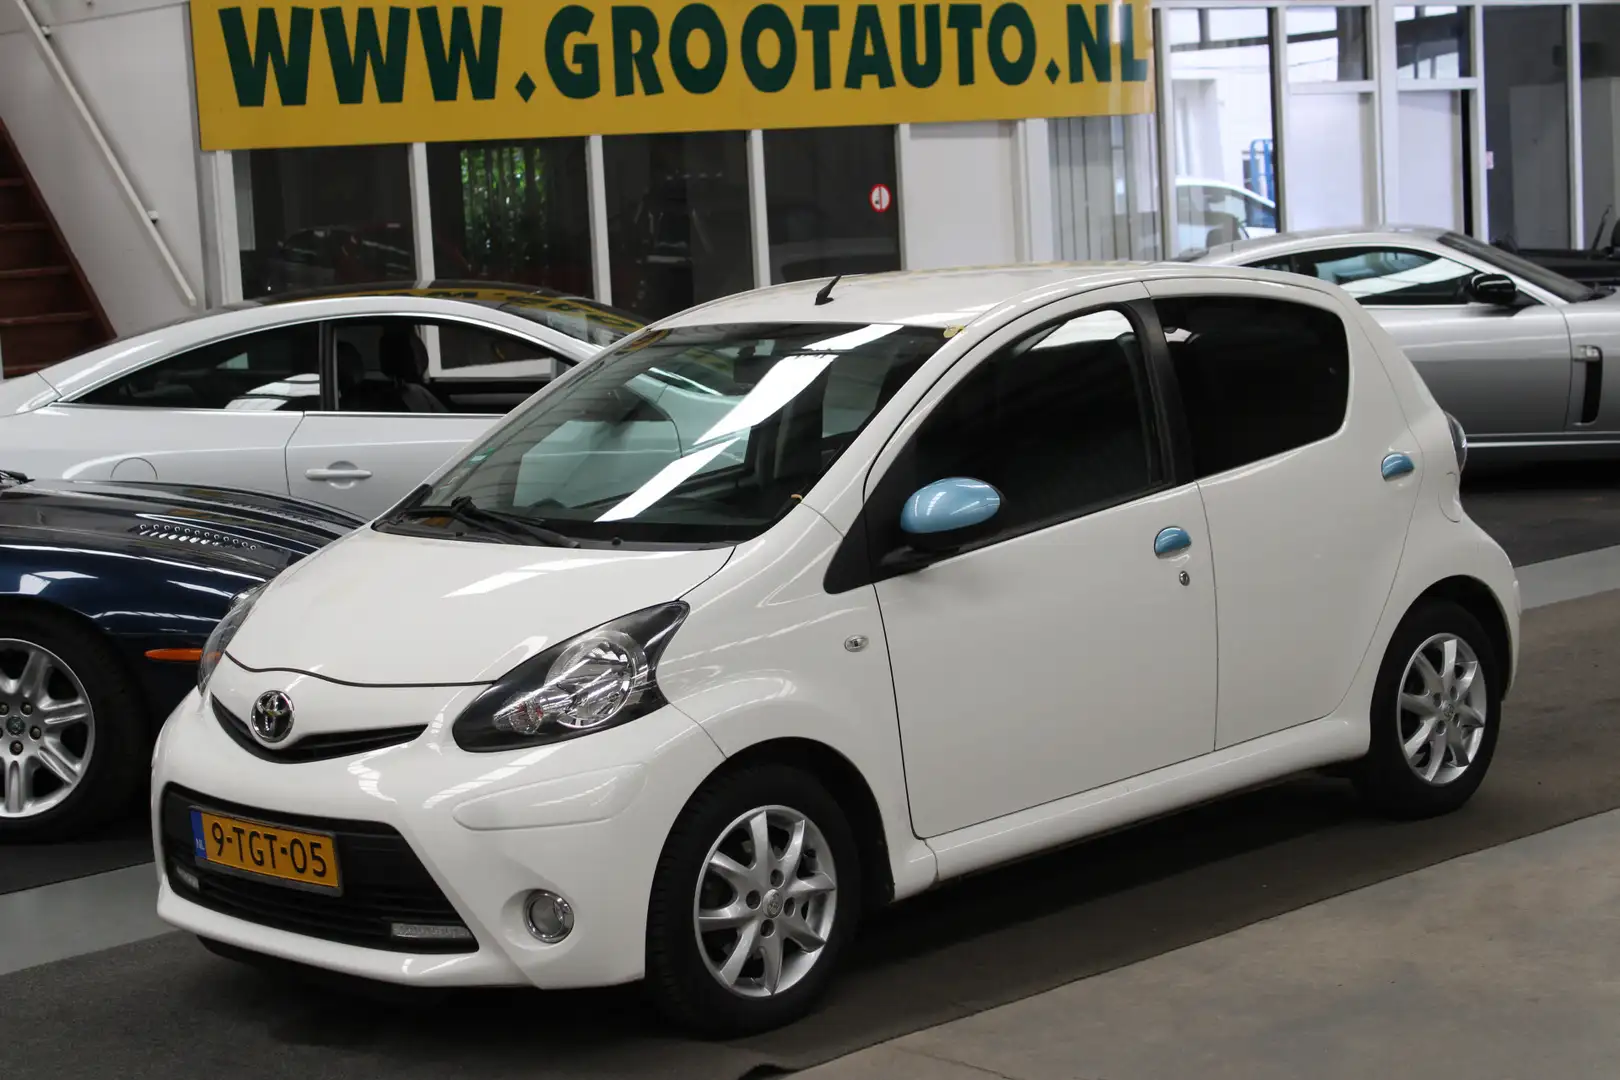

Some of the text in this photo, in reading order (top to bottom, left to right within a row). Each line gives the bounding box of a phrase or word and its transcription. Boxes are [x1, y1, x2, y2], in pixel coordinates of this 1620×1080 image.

[218, 3, 1148, 107] WWW.GROOTAUTO.NL
[195, 838, 206, 850] NL
[211, 822, 327, 877] 9-TGT-05
